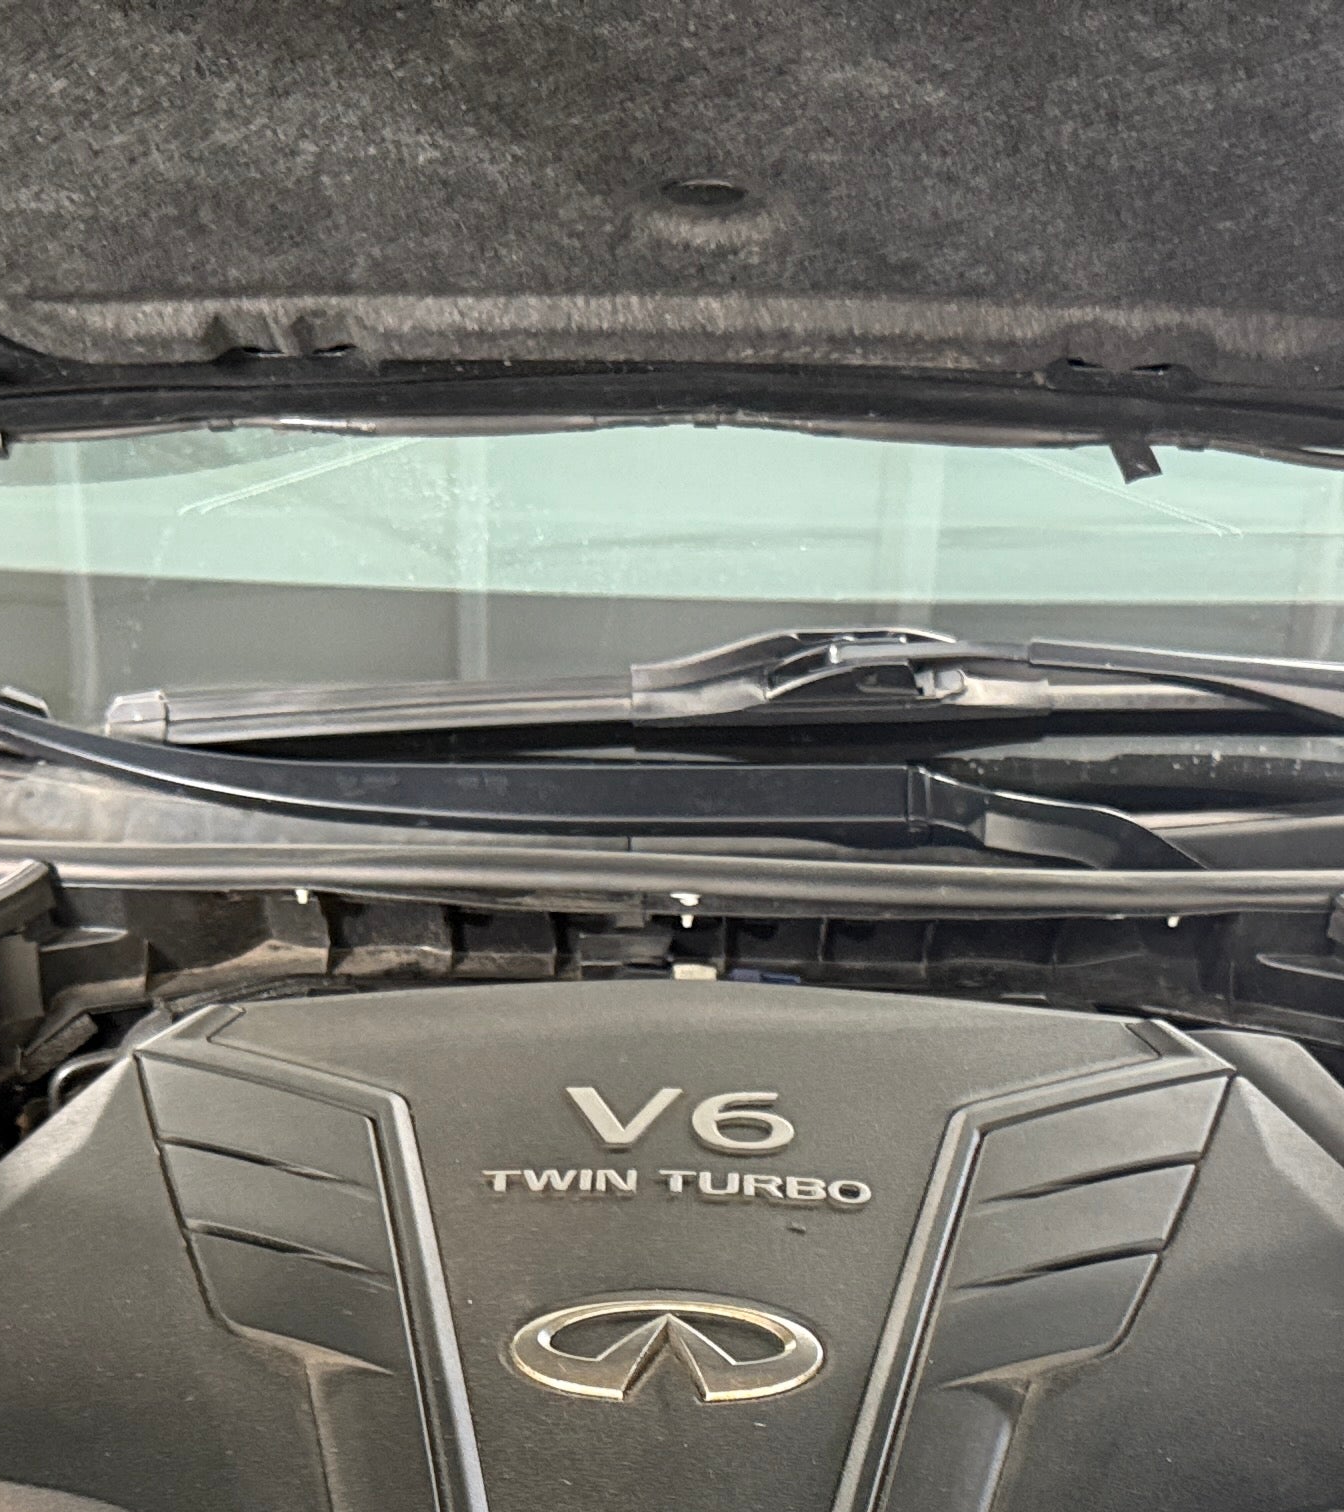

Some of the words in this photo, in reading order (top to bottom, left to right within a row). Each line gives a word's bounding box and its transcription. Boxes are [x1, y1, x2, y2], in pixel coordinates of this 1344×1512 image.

[566, 1086, 795, 1155] V6
[482, 1169, 638, 1194] TWIN
[659, 1169, 873, 1205] TURBO
